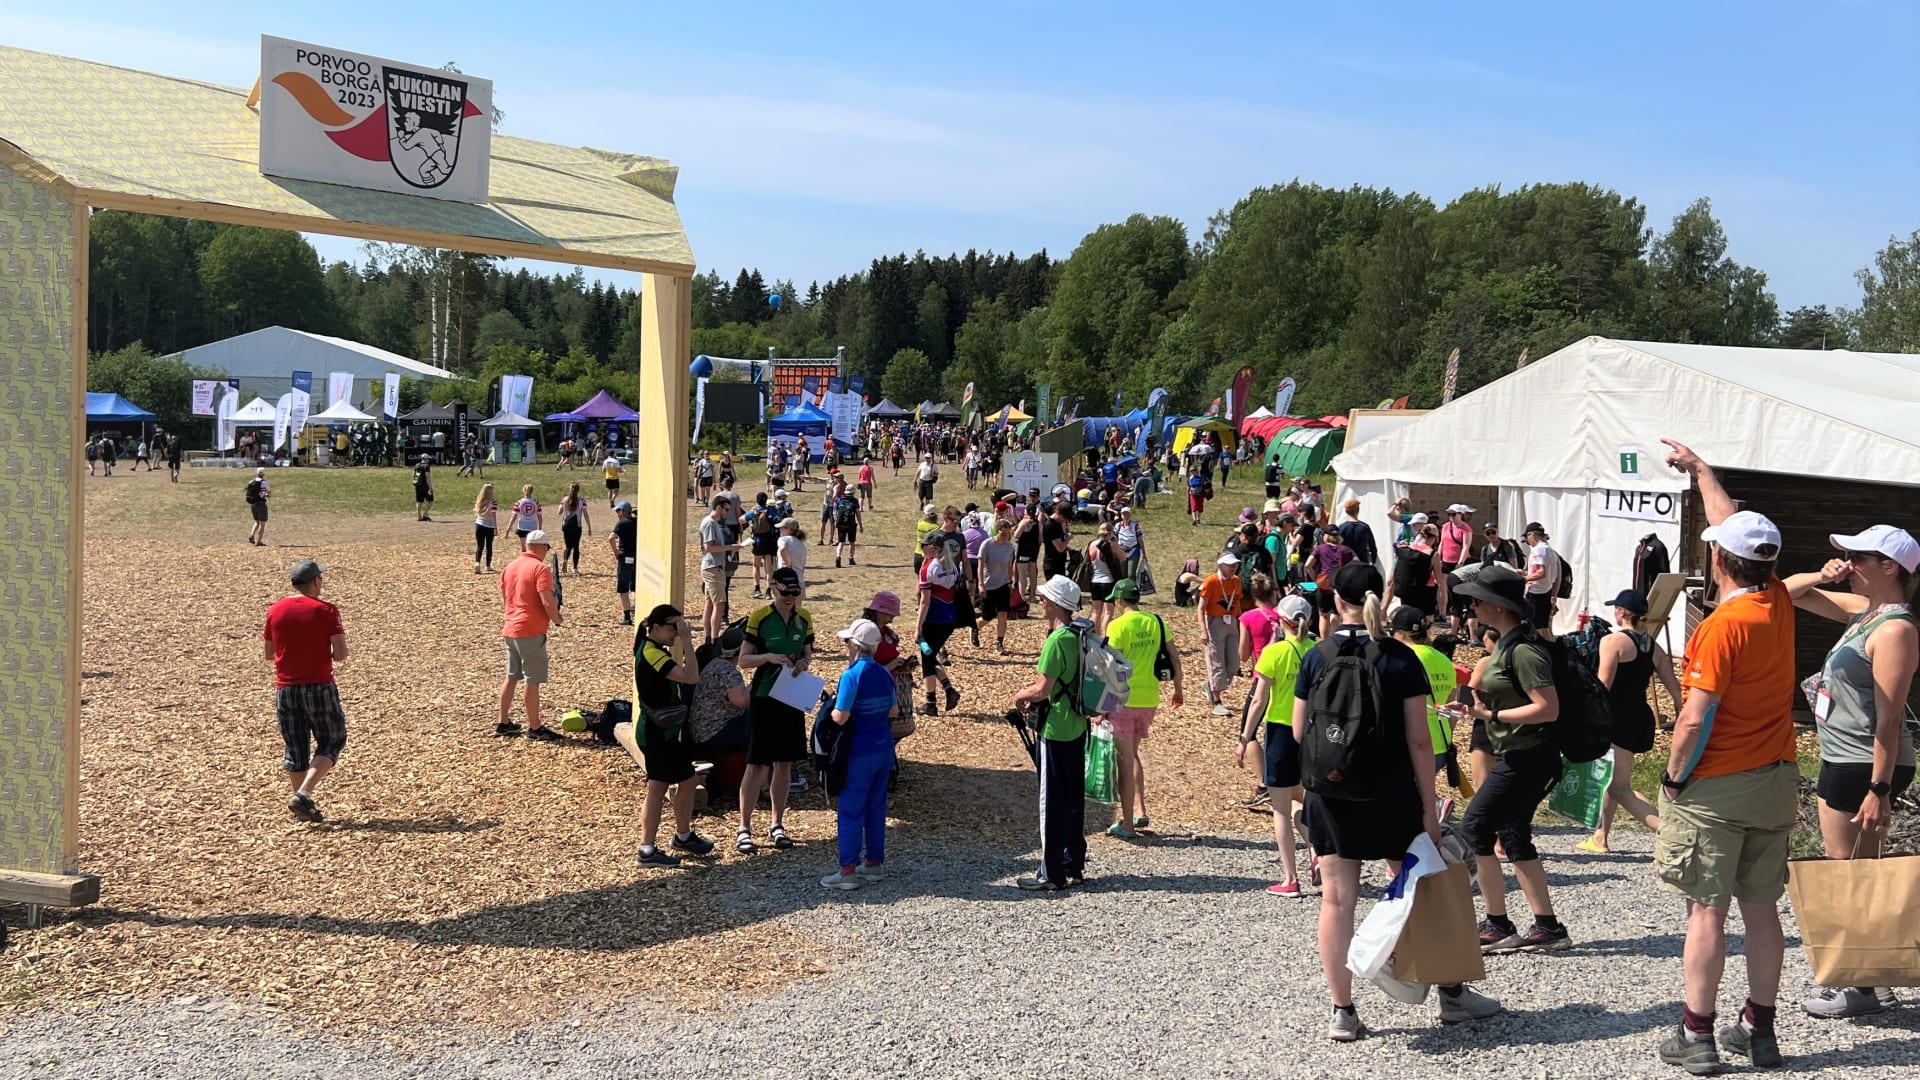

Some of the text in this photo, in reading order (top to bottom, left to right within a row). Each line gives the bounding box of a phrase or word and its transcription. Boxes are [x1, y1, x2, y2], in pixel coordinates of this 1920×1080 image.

[296, 49, 371, 76] PORVOO
[321, 69, 382, 94] BORGÅ
[388, 73, 462, 102] JUKOLAN
[338, 89, 375, 108] 2023
[399, 92, 451, 116] VIESTI
[525, 505, 532, 514] P
[1605, 489, 1672, 515] INFO
